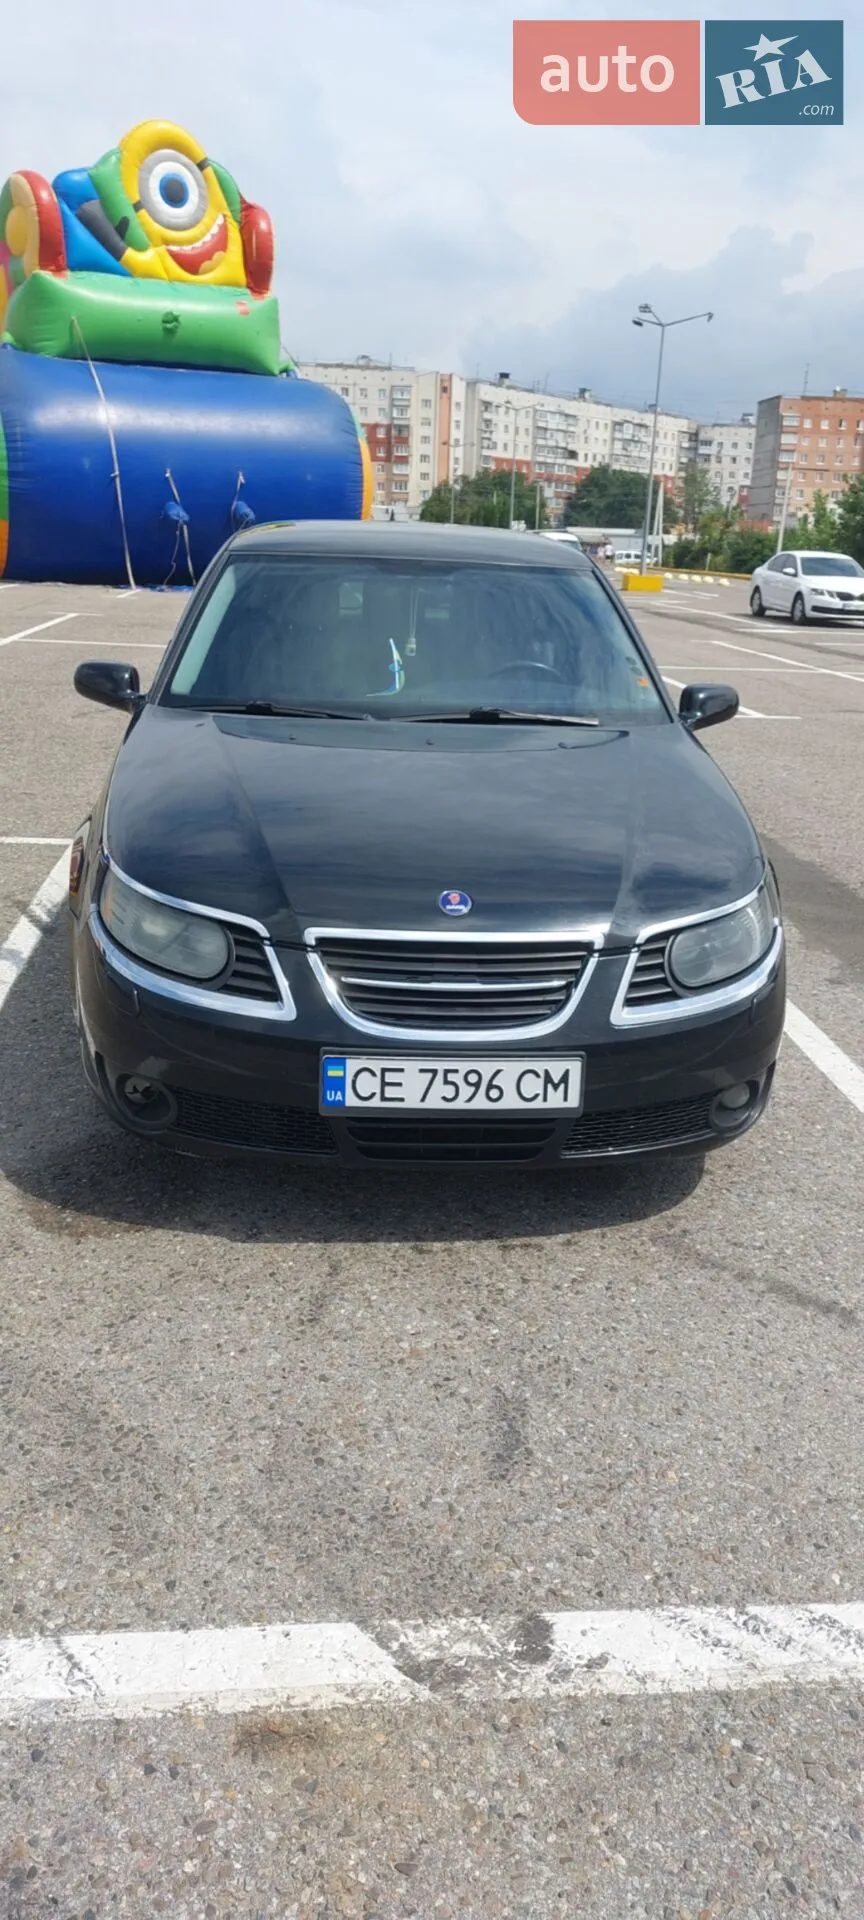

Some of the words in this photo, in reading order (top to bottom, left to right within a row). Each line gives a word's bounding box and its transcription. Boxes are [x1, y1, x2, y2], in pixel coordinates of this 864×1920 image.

[326, 1090, 343, 1101] UA
[351, 1067, 405, 1102] CE
[418, 1069, 505, 1103] 7596
[516, 1069, 570, 1103] CM
